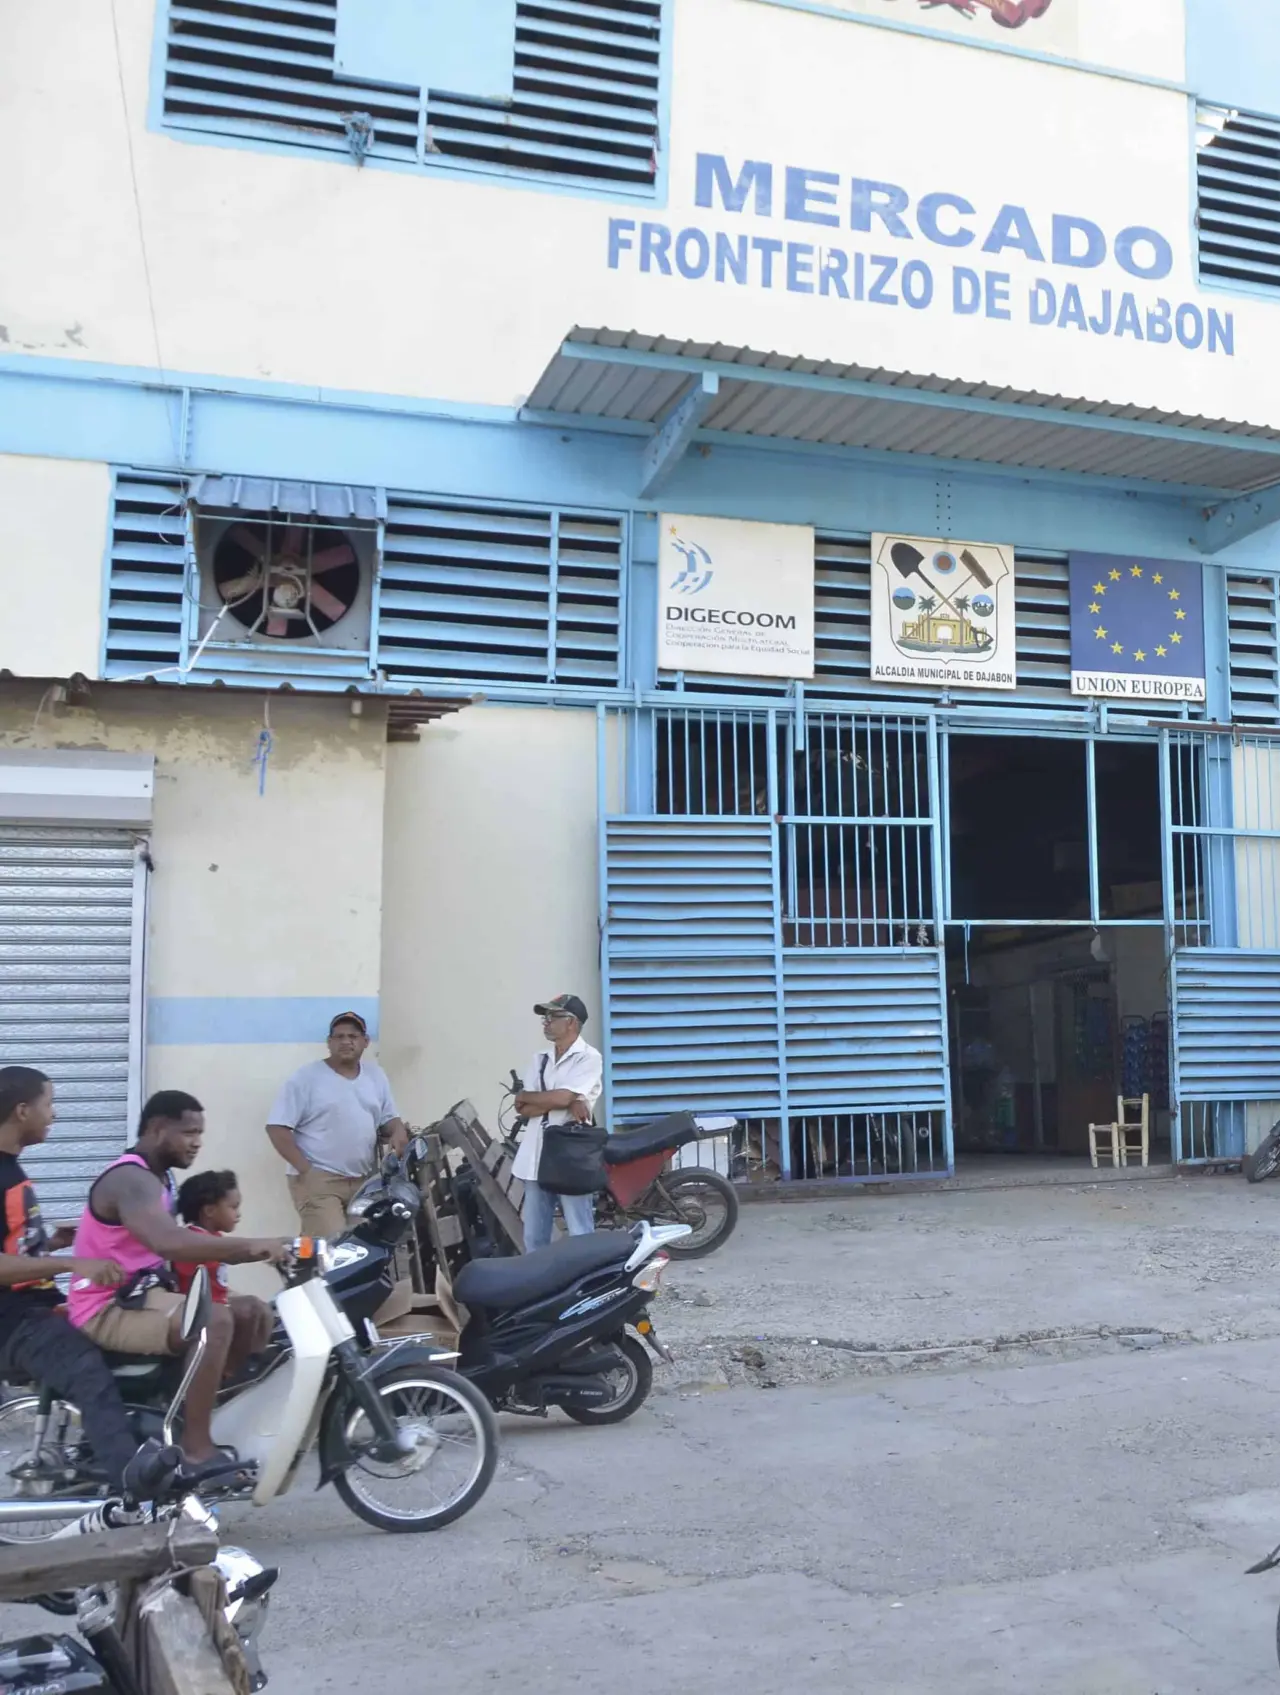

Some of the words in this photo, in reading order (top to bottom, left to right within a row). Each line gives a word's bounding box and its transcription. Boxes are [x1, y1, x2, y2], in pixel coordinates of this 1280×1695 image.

[695, 152, 1173, 281] MERCADO
[608, 217, 934, 310] FRONTERIZO
[952, 265, 1011, 320] DE
[1028, 278, 1234, 356] DAJABON
[666, 606, 796, 629] DIGECOOM
[875, 665, 915, 677] ALCALDIA
[917, 668, 961, 680] MUNICIPAL
[963, 671, 974, 680] DE
[976, 671, 1013, 683] DAJABON
[1076, 677, 1127, 693] UNION
[1131, 680, 1203, 697] EUROPEA
